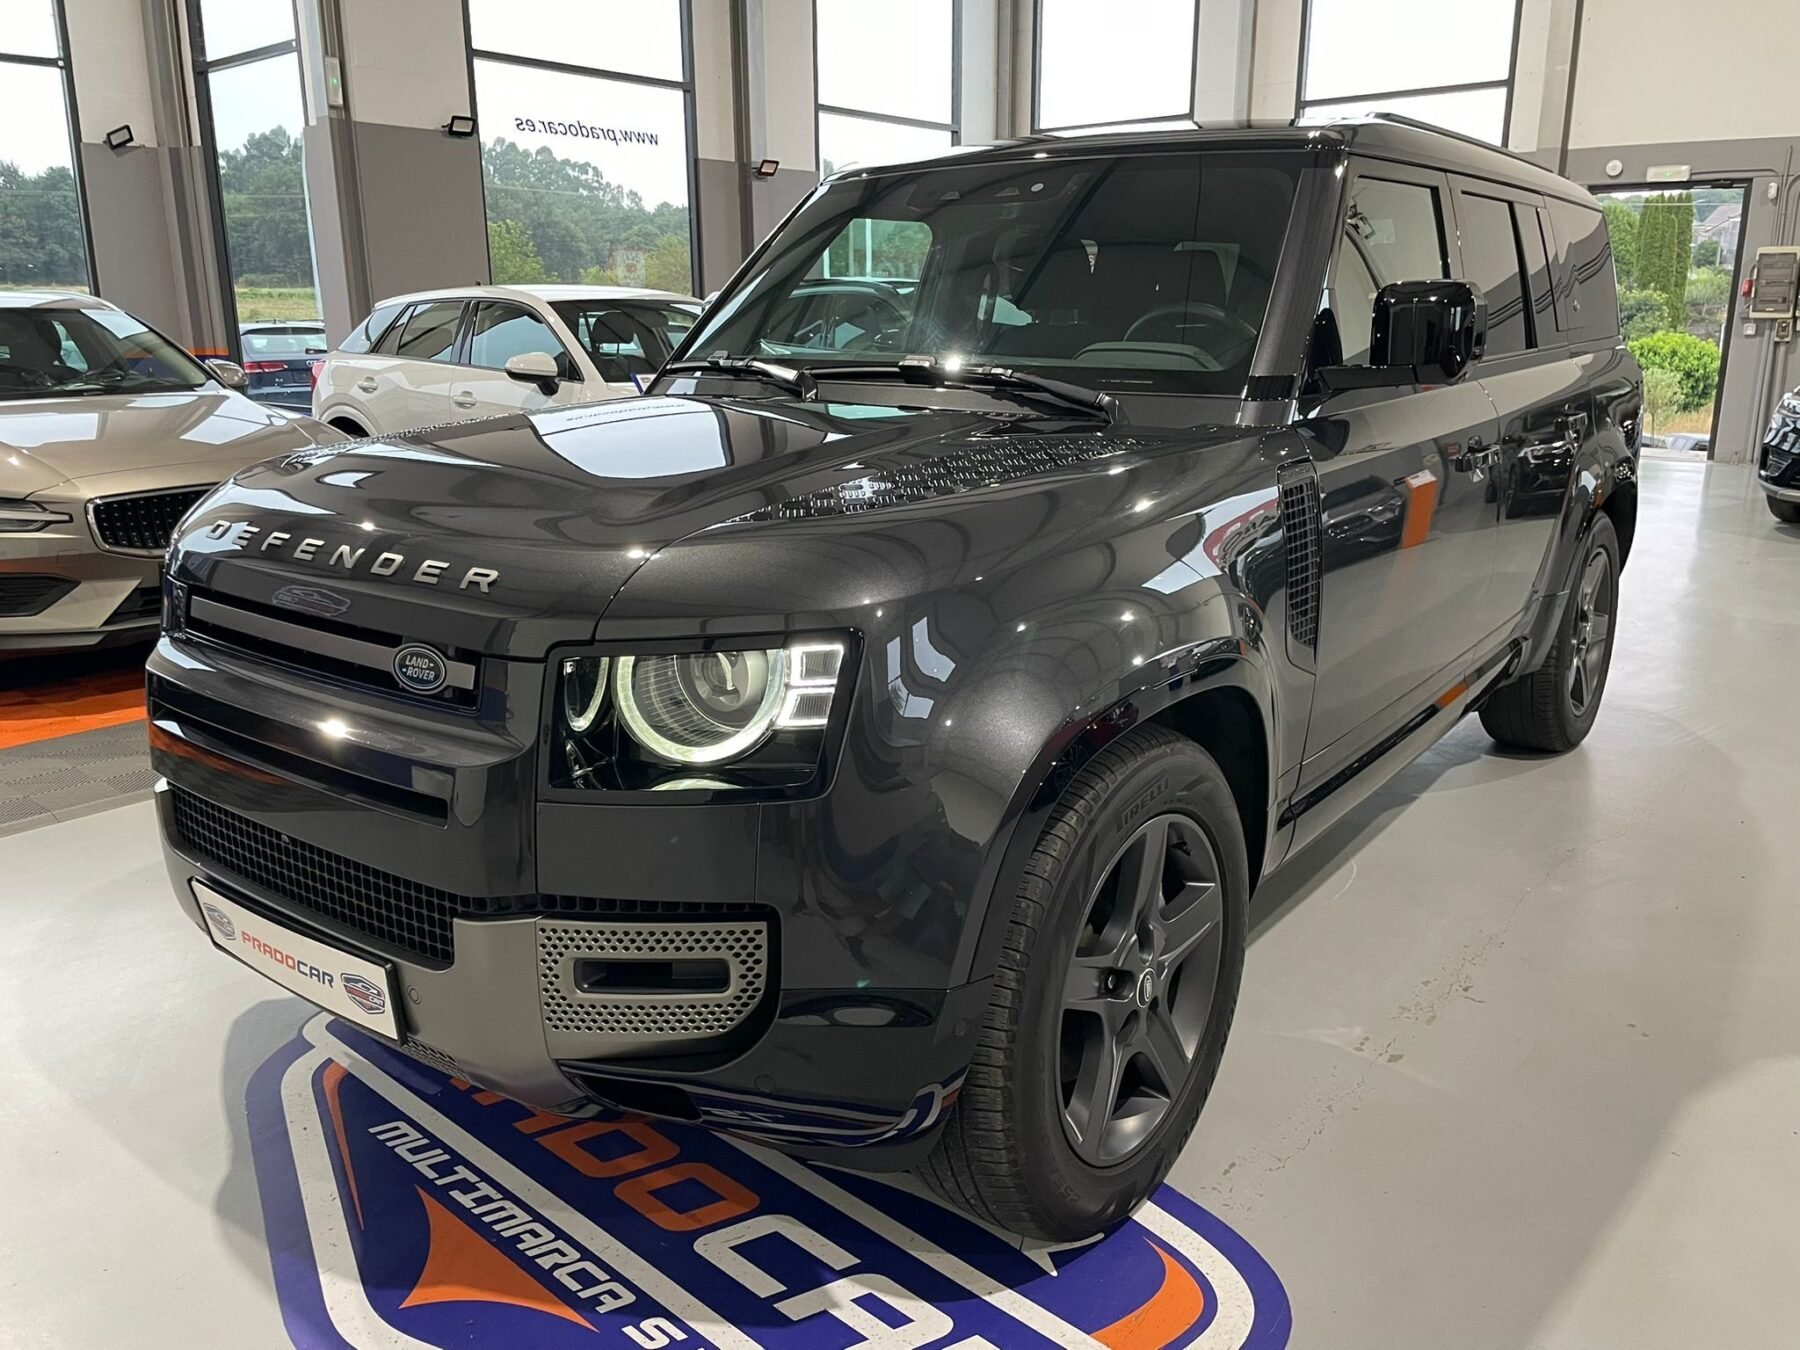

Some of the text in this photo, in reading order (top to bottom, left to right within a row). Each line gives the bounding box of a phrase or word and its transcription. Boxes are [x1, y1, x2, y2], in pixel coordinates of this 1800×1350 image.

[205, 519, 499, 593] DEFENDER
[241, 930, 334, 989] PRADOCAR
[368, 1121, 704, 1350] MULTIMARCA S
